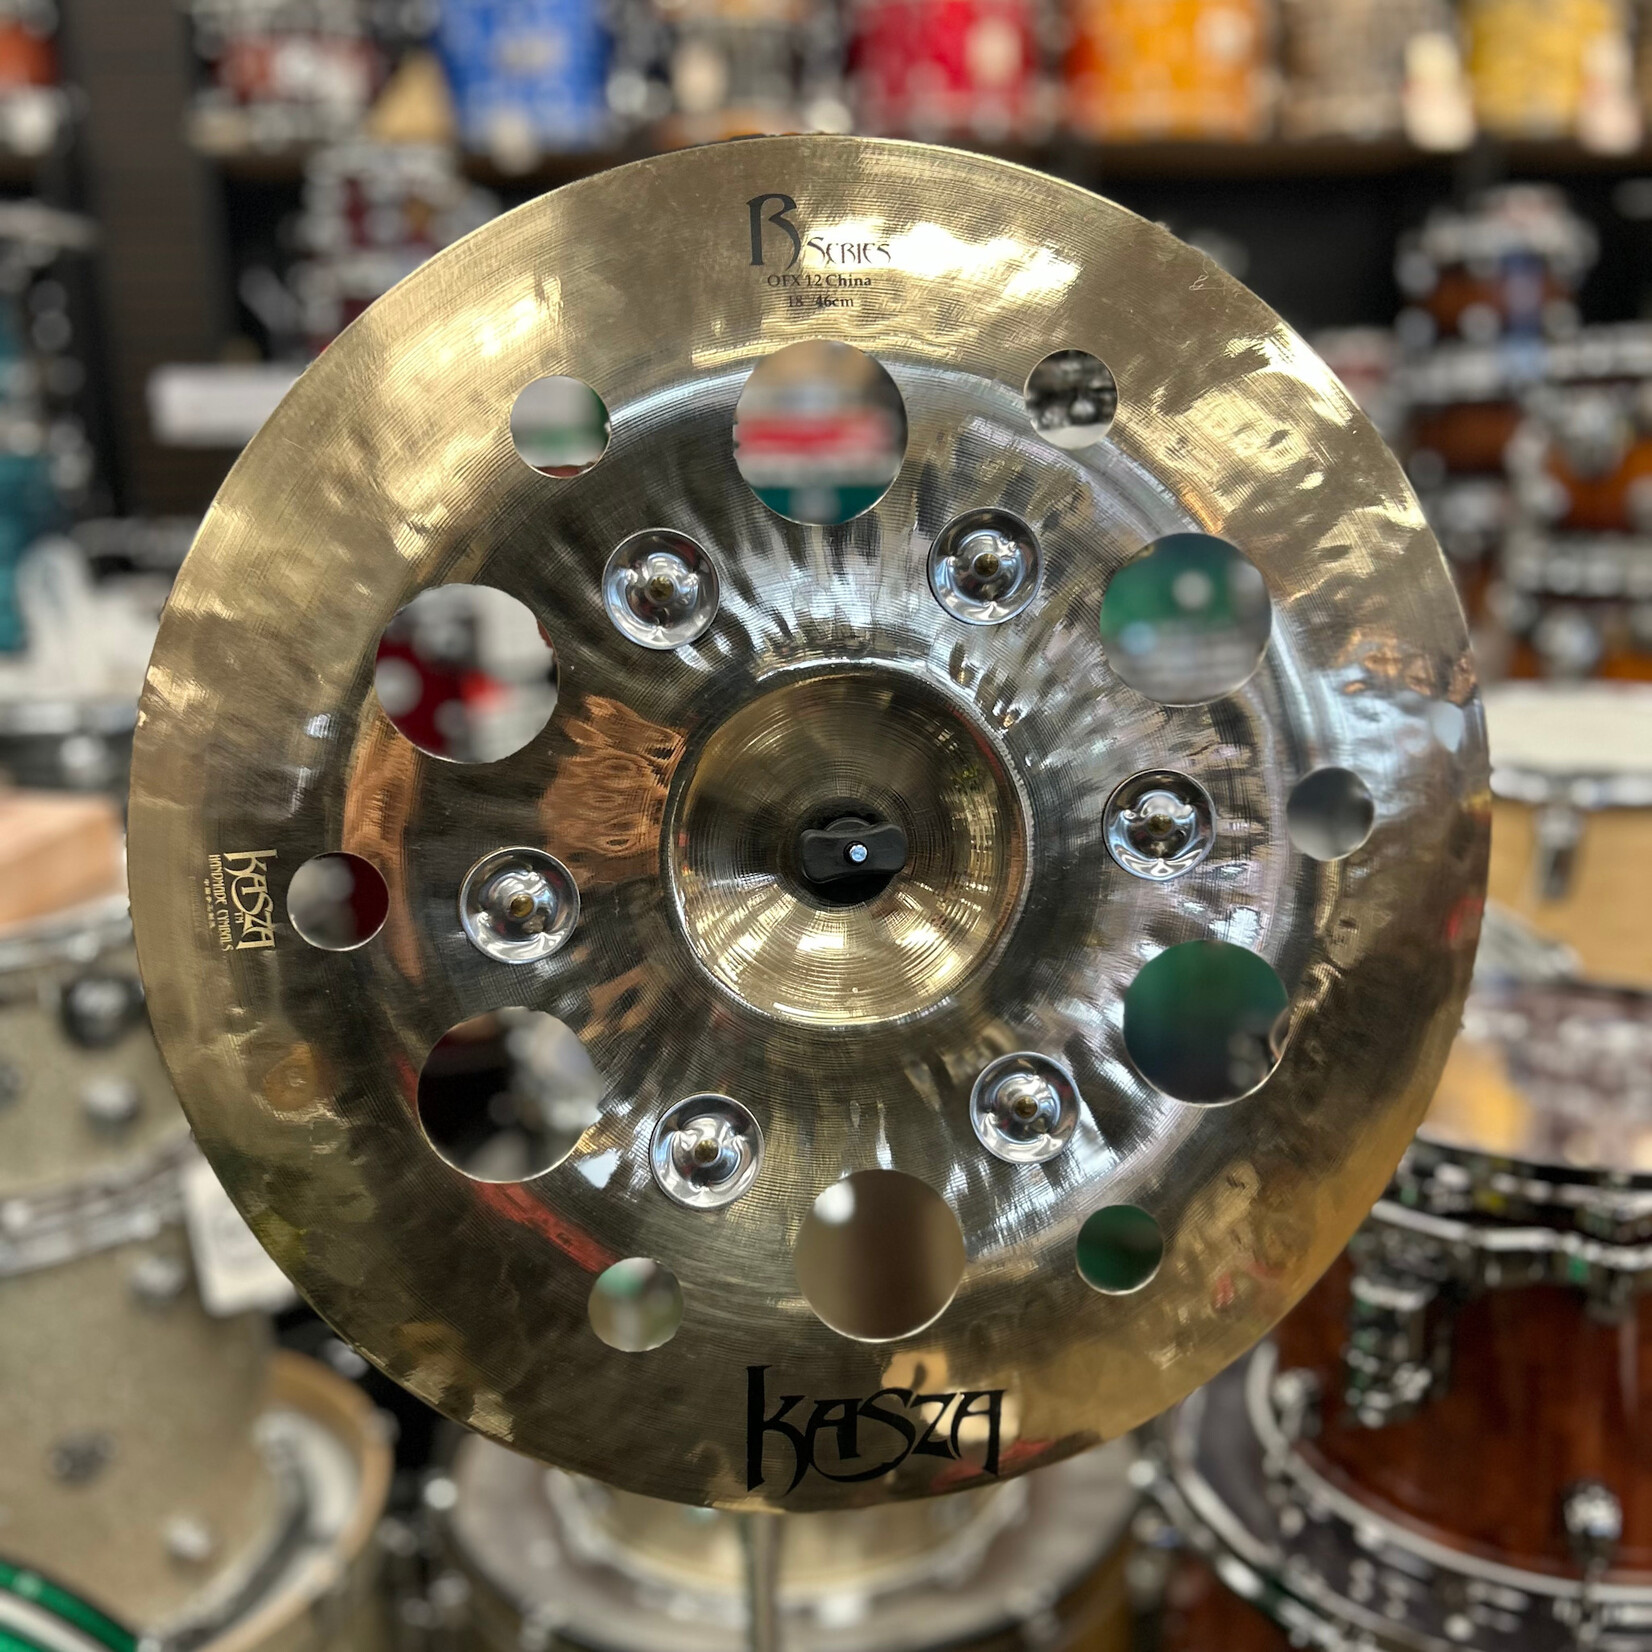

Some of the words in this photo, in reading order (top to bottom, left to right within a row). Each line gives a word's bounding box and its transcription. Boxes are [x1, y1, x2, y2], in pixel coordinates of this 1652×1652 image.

[767, 274, 801, 287] OFX
[805, 274, 823, 287] 12
[825, 274, 872, 287] China
[208, 854, 228, 905] HANDMADE
[223, 849, 278, 950] KASZA
[216, 909, 235, 952] CYMBALS
[746, 1364, 1007, 1496] KASZA
